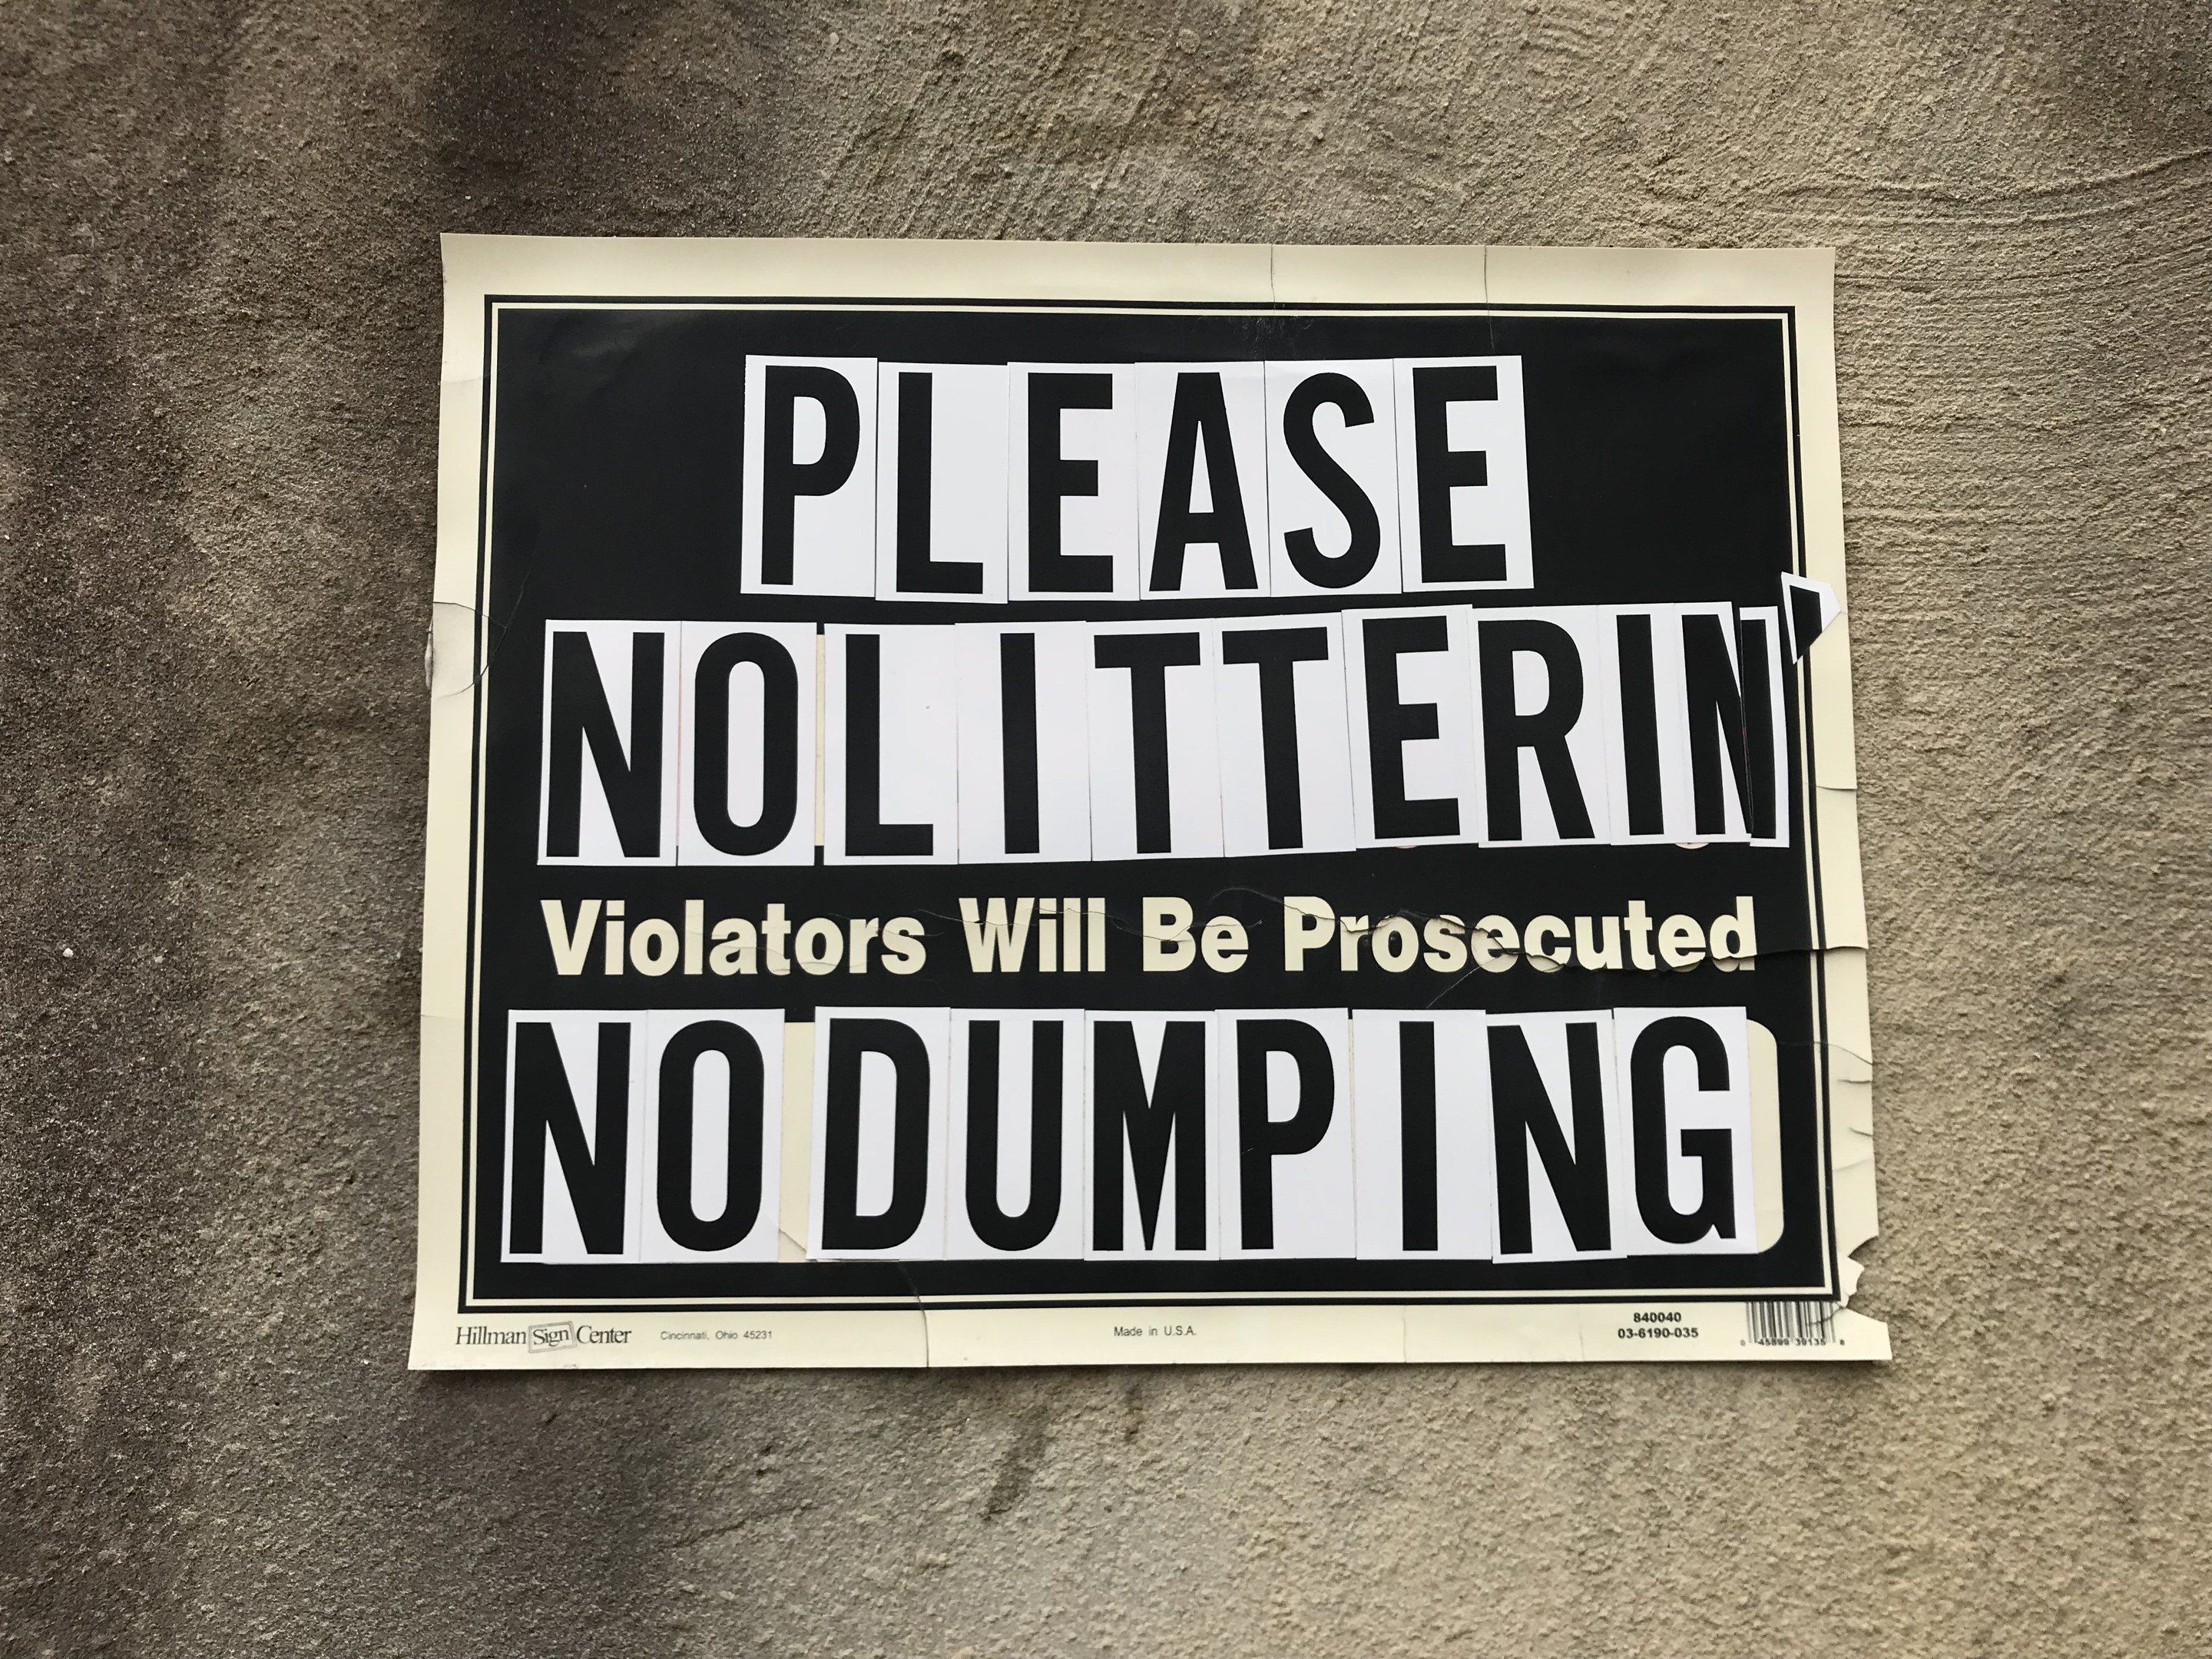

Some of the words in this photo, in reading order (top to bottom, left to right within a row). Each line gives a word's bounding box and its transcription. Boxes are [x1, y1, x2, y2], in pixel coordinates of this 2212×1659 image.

[761, 365, 1508, 594] PLEASE
[547, 631, 799, 858] NO
[540, 899, 927, 976] Violators
[958, 897, 1106, 973] Will
[1143, 896, 1249, 974] Be
[1283, 896, 1755, 974] Prosecuted
[508, 1020, 764, 1255] NO
[822, 1016, 1737, 1255] DUMPING
[1633, 1311, 1682, 1323] 840040
[455, 1326, 527, 1345] Hillman
[532, 1327, 570, 1347] Sign
[576, 1325, 632, 1343] Center
[660, 1330, 710, 1340] Cincinnati,
[715, 1330, 738, 1339] Ohio
[743, 1330, 773, 1339] 45231
[1114, 1326, 1143, 1336] Made
[1148, 1326, 1158, 1336] in
[1164, 1325, 1197, 1336] U.S.A.
[1618, 1327, 1699, 1339] 03-6190-035
